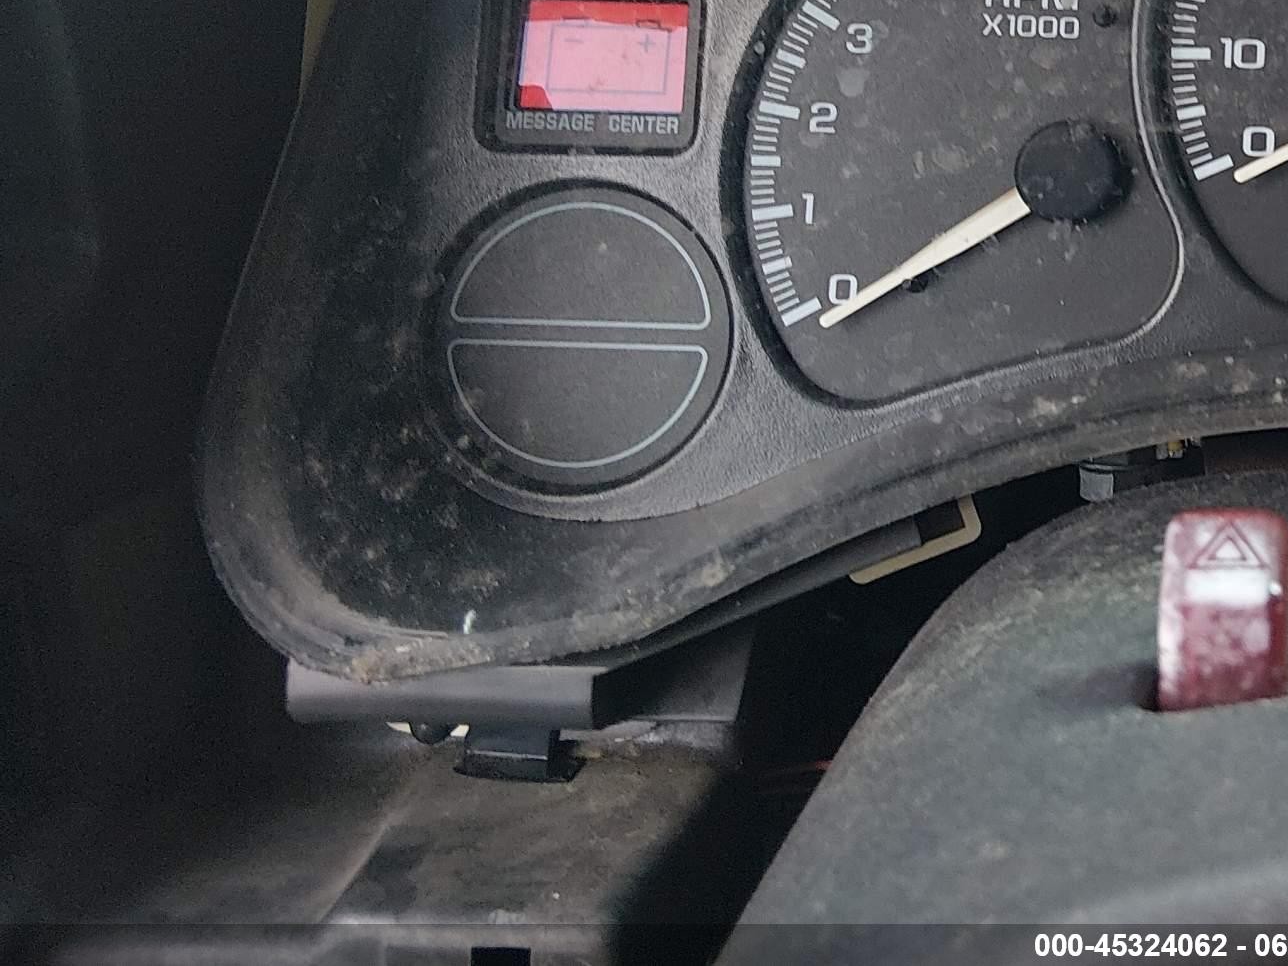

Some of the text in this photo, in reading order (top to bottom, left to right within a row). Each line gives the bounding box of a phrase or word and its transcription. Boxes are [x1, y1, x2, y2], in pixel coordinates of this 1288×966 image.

[846, 23, 873, 54] 3
[983, 14, 1080, 39] X1000
[1221, 38, 1266, 70] 10
[506, 111, 679, 135] MESSAGE CENTER
[809, 102, 837, 133] 2
[1242, 126, 1276, 158] 0
[802, 192, 815, 225] 1
[828, 274, 858, 305] 0
